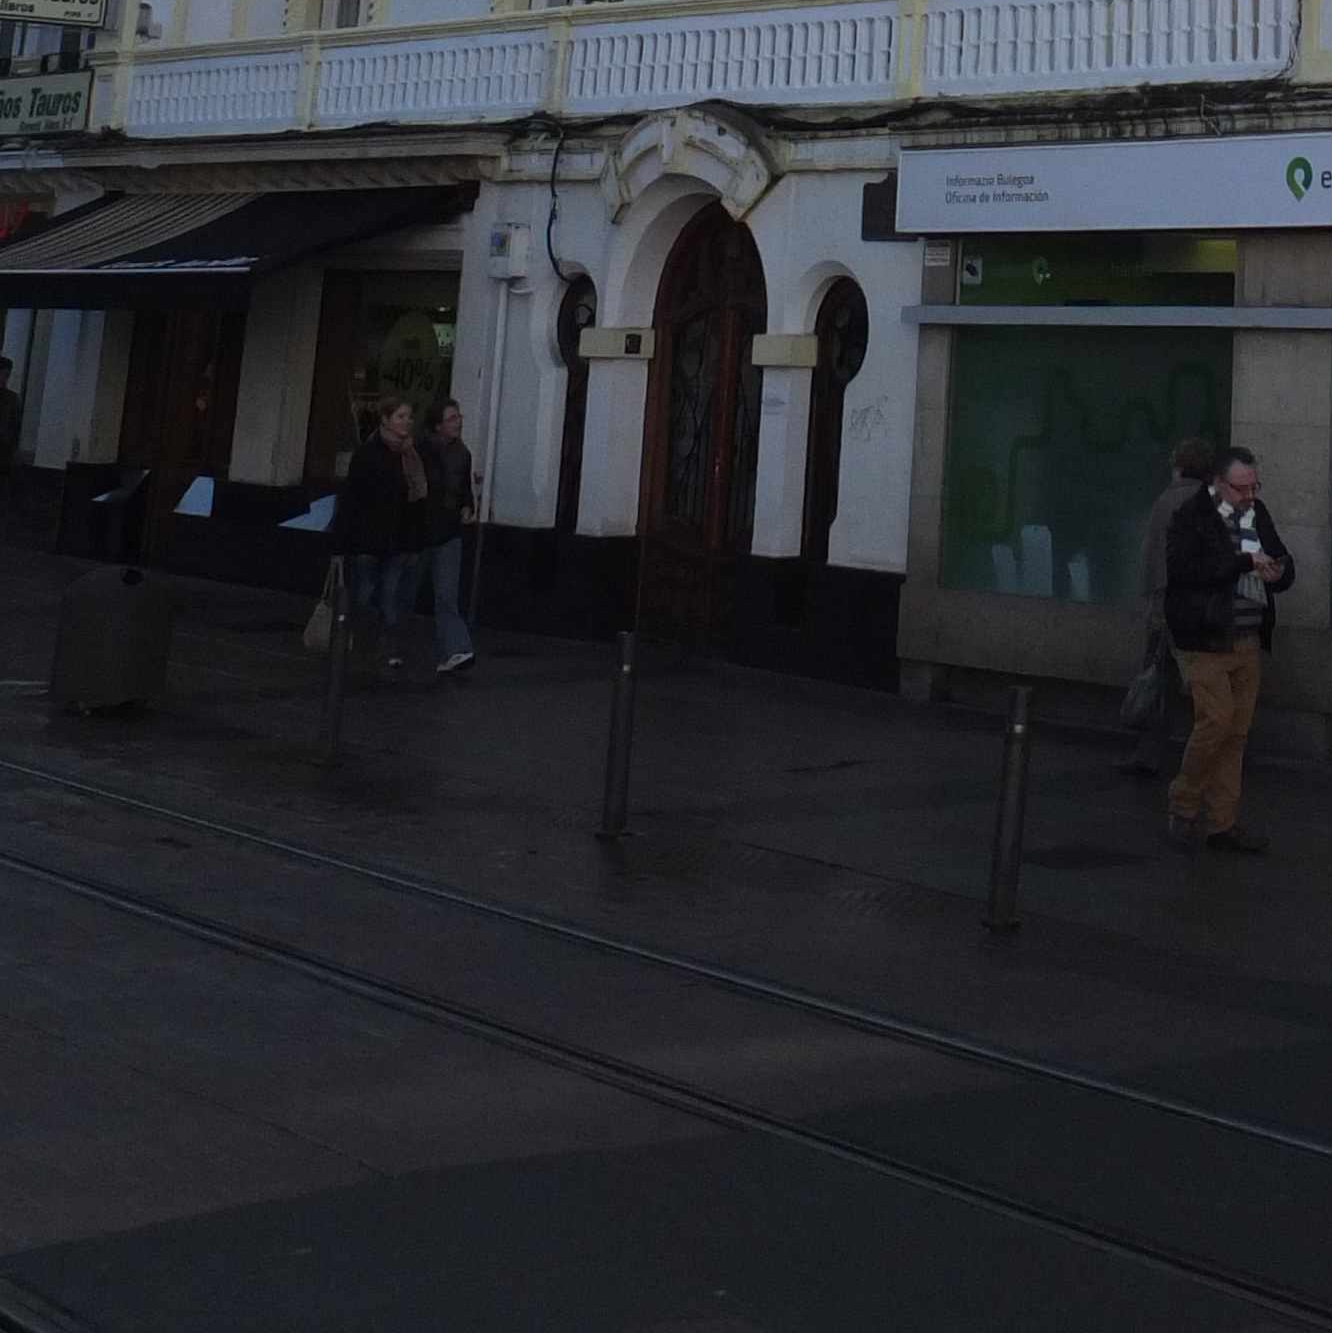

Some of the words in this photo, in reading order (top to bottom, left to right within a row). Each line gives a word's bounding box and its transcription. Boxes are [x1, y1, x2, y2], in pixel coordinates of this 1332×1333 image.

[28, 87, 82, 117] Tauros
[946, 175, 995, 187] Informazio
[997, 173, 1035, 189] Bulegoa
[945, 191, 976, 204] Oficina
[979, 193, 990, 203] de
